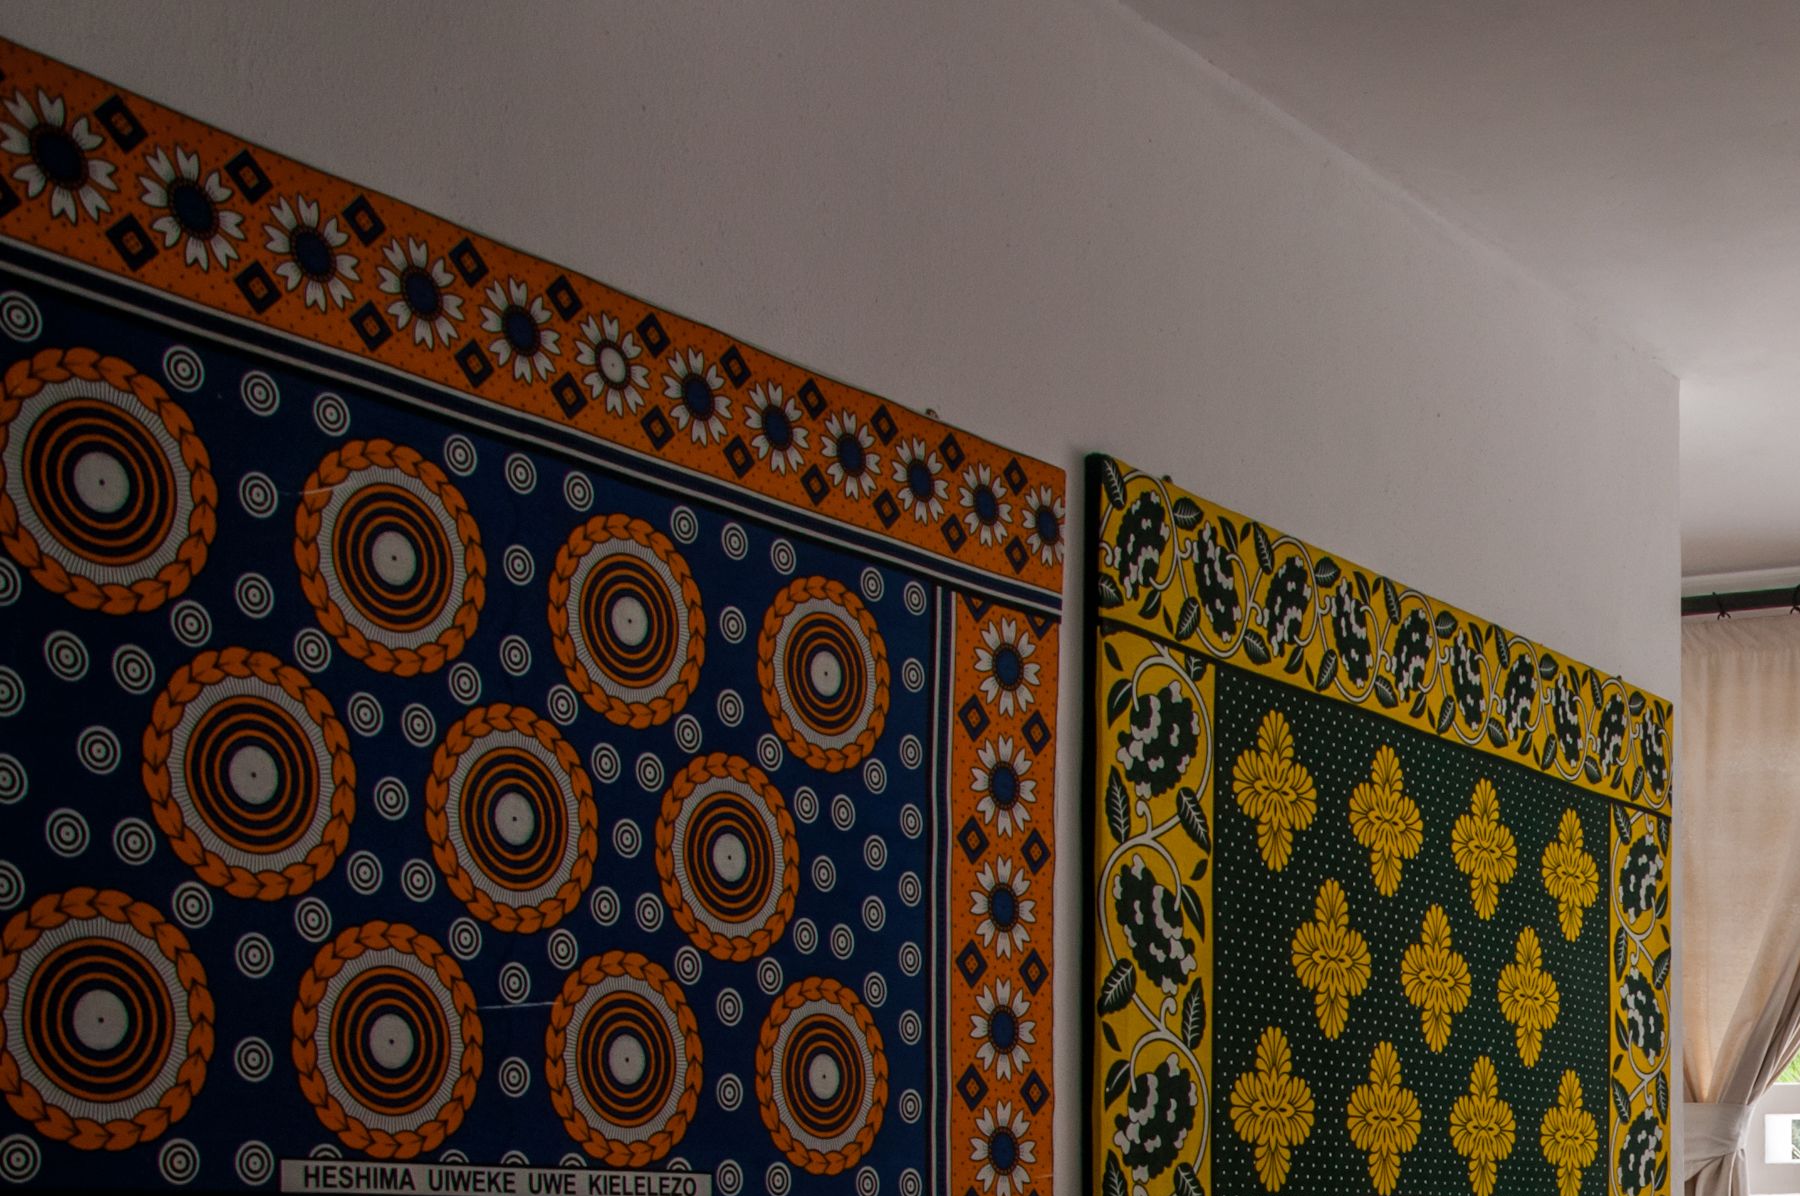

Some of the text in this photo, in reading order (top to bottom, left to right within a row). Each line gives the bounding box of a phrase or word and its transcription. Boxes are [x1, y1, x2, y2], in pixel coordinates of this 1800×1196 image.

[303, 1165, 415, 1191] HESHIMA
[427, 1168, 517, 1194] UIWEKE
[527, 1171, 577, 1195] UWE
